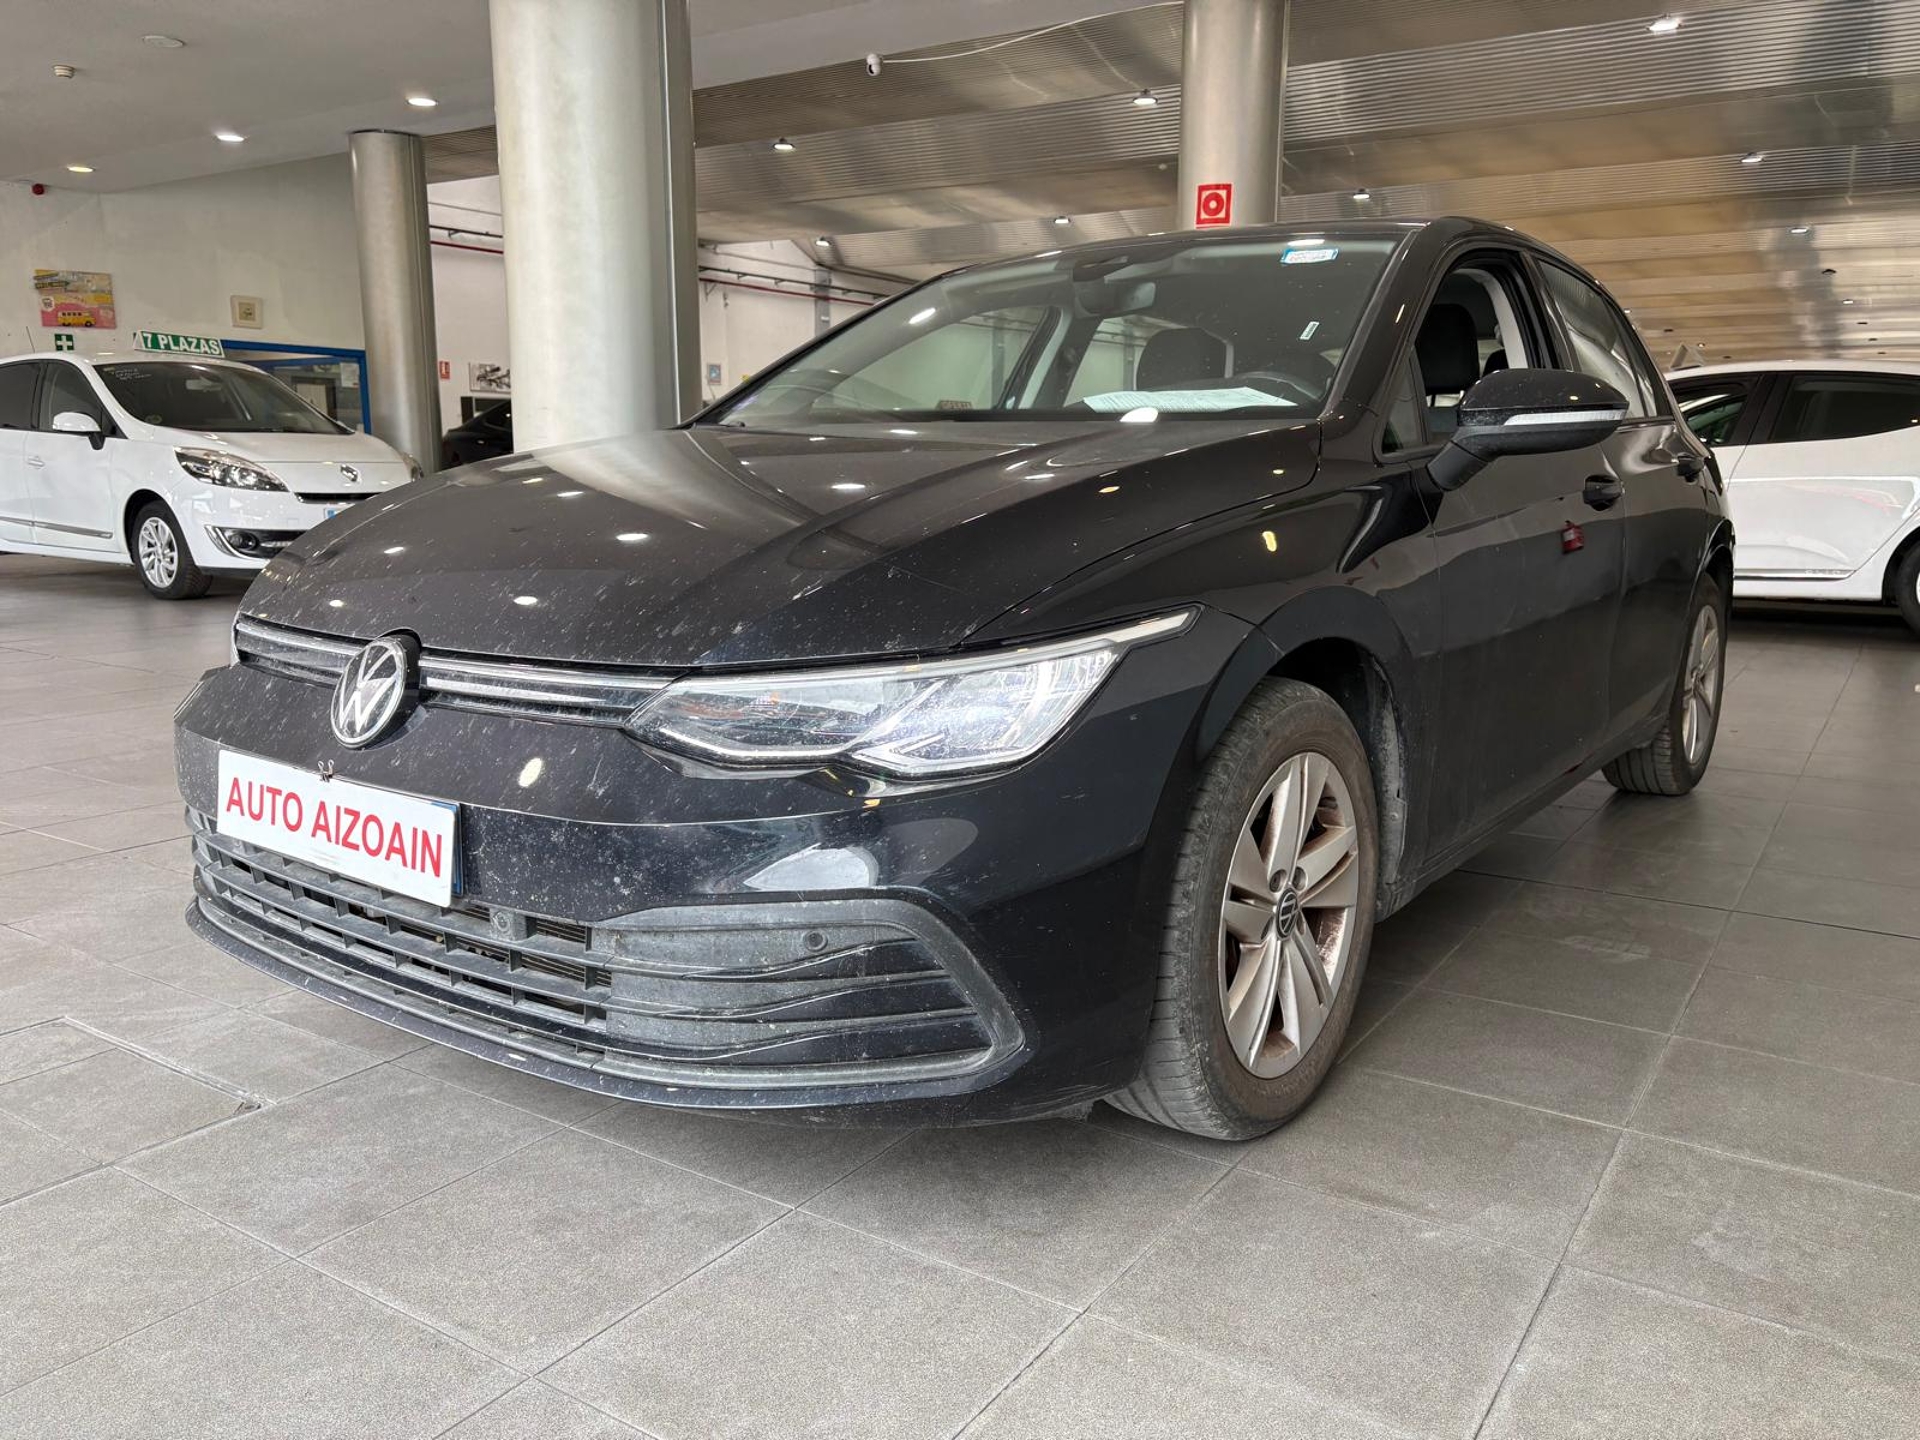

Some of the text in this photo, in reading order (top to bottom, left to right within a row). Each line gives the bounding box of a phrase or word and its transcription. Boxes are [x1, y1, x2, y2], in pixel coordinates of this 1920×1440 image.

[143, 333, 220, 355] 7 PLAZAS
[226, 777, 442, 877] AUTO AIZOAIN
